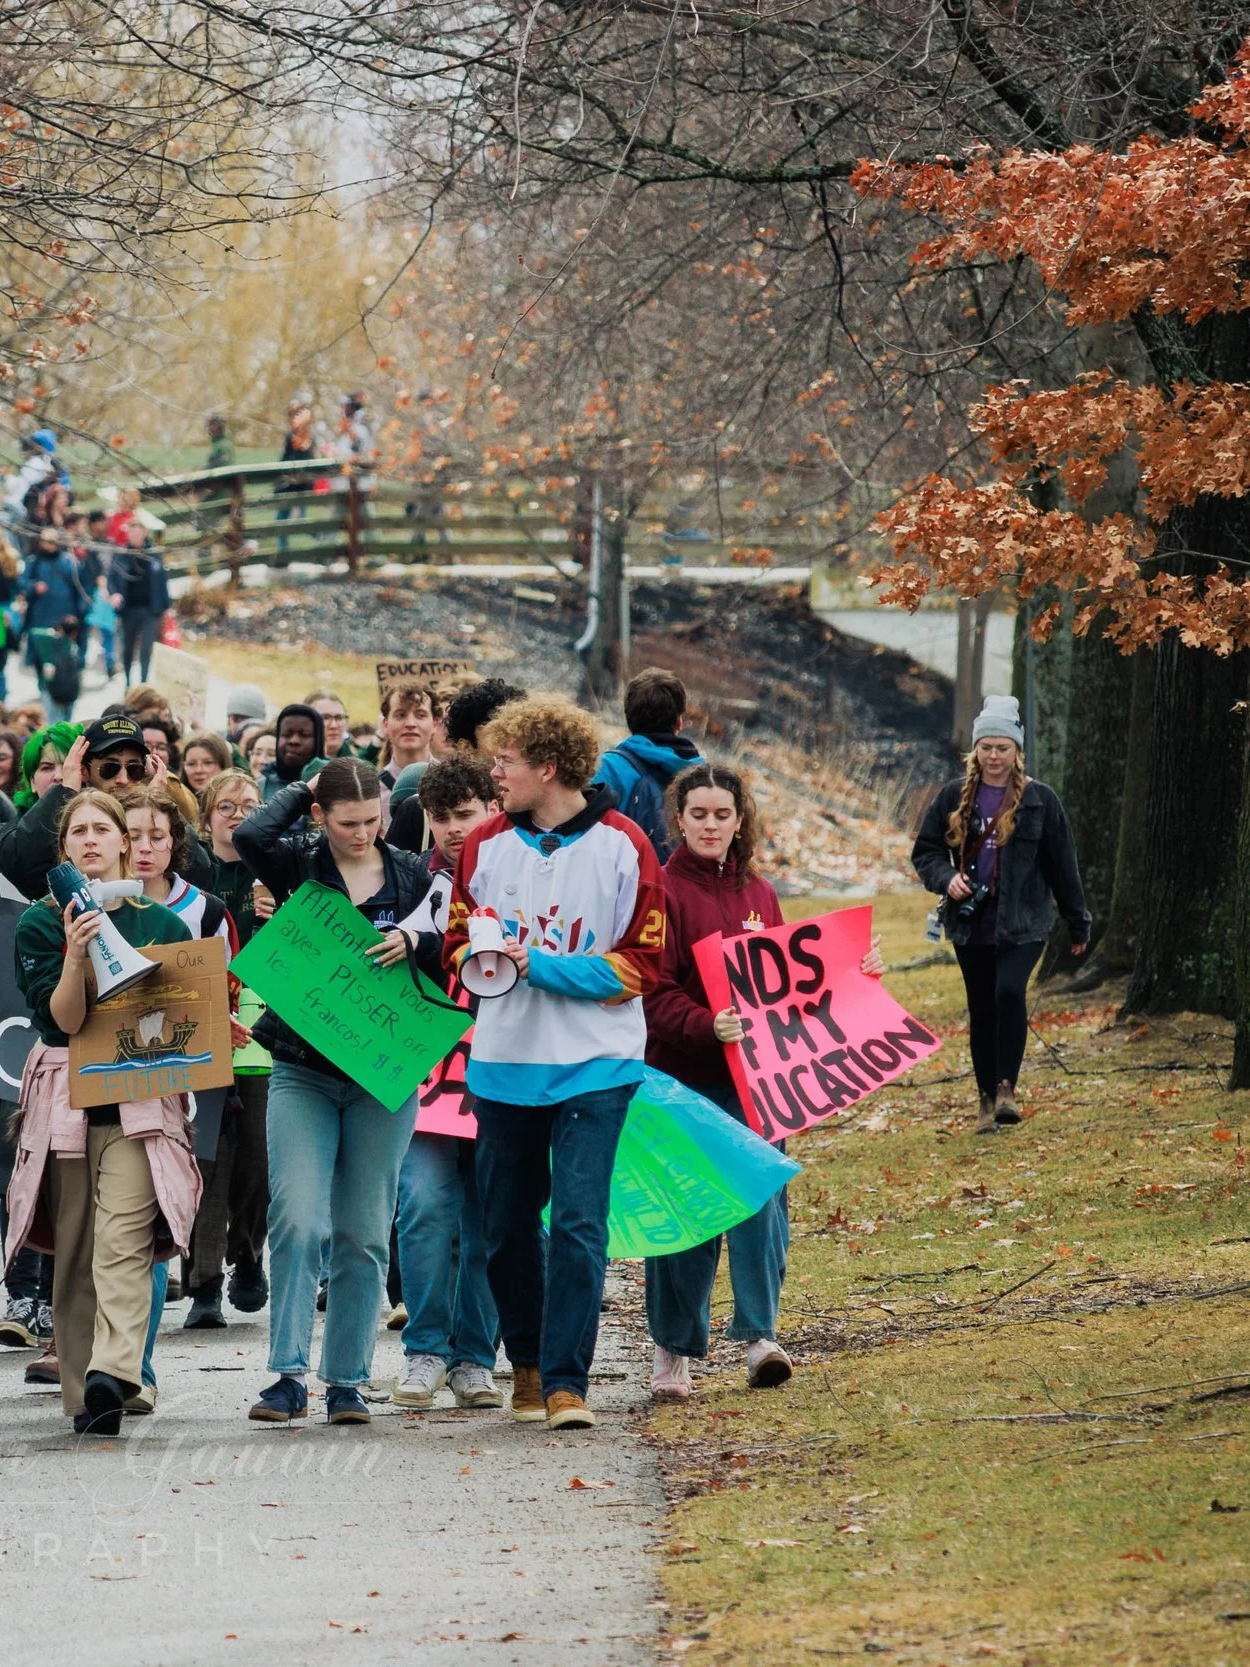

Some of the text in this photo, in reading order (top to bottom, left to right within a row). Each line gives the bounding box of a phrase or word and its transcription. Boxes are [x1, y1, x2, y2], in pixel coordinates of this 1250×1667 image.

[264, 949, 292, 981] les
[302, 985, 373, 1055] francos!
[280, 918, 322, 966] avez
[326, 963, 399, 1040] PISSER
[765, 989, 847, 1062] MY
[104, 1064, 196, 1101] FUTURE
